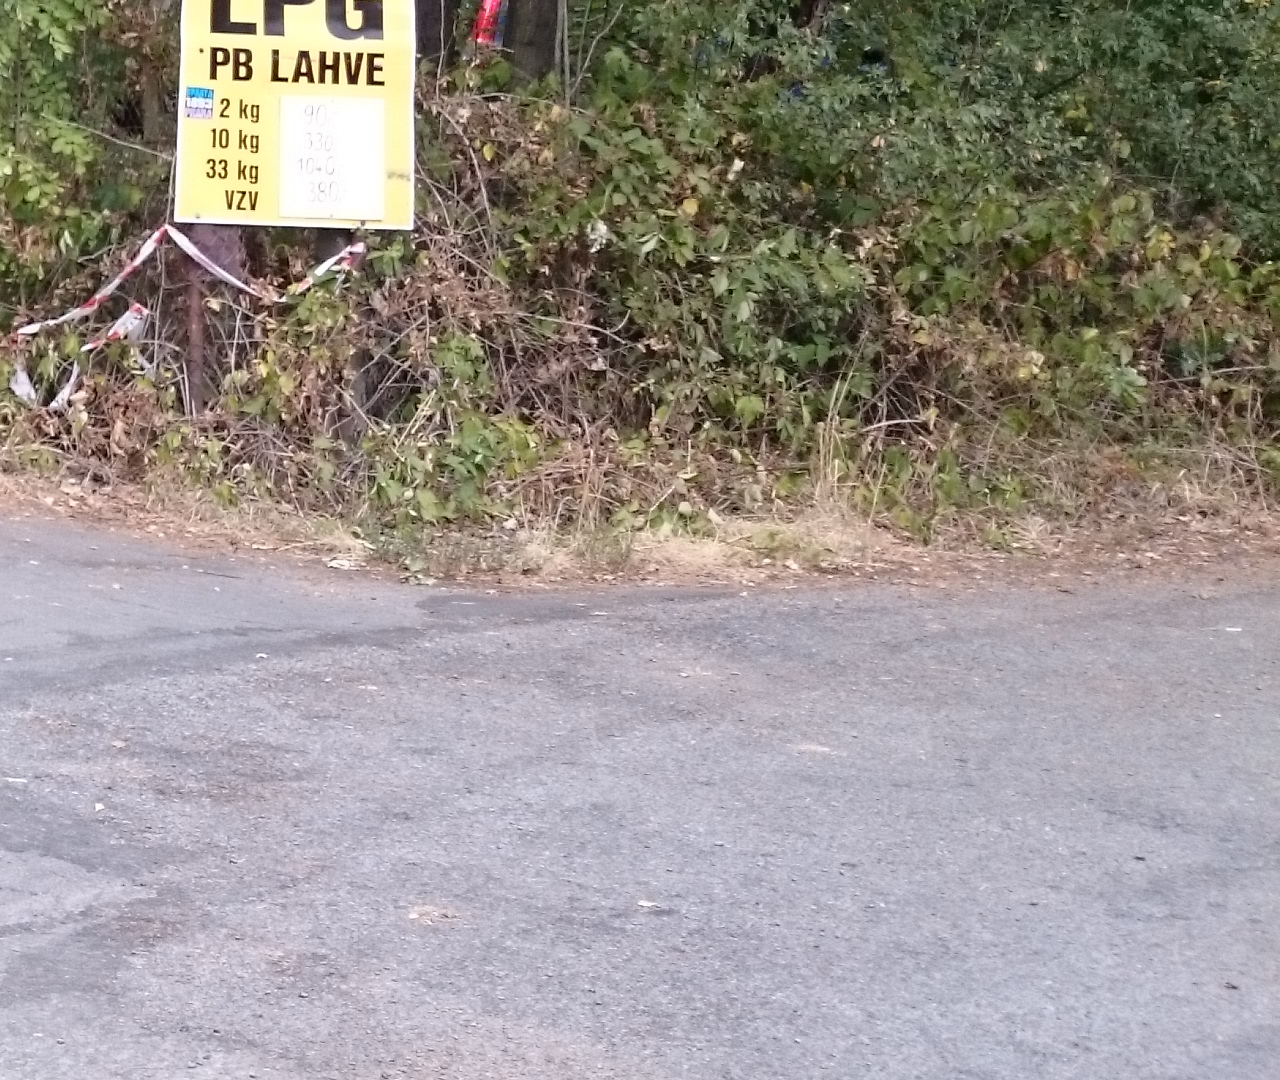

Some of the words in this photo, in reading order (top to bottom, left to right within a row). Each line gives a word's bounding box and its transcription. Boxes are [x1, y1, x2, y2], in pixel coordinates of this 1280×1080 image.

[209, 47, 253, 81] PB
[270, 49, 385, 86] LAHVE
[219, 98, 230, 118] 2
[239, 99, 260, 123] kg
[211, 128, 230, 149] 10
[238, 129, 259, 154] kg
[206, 159, 228, 179] 33
[237, 160, 259, 185] kg
[225, 190, 259, 211] VZV
